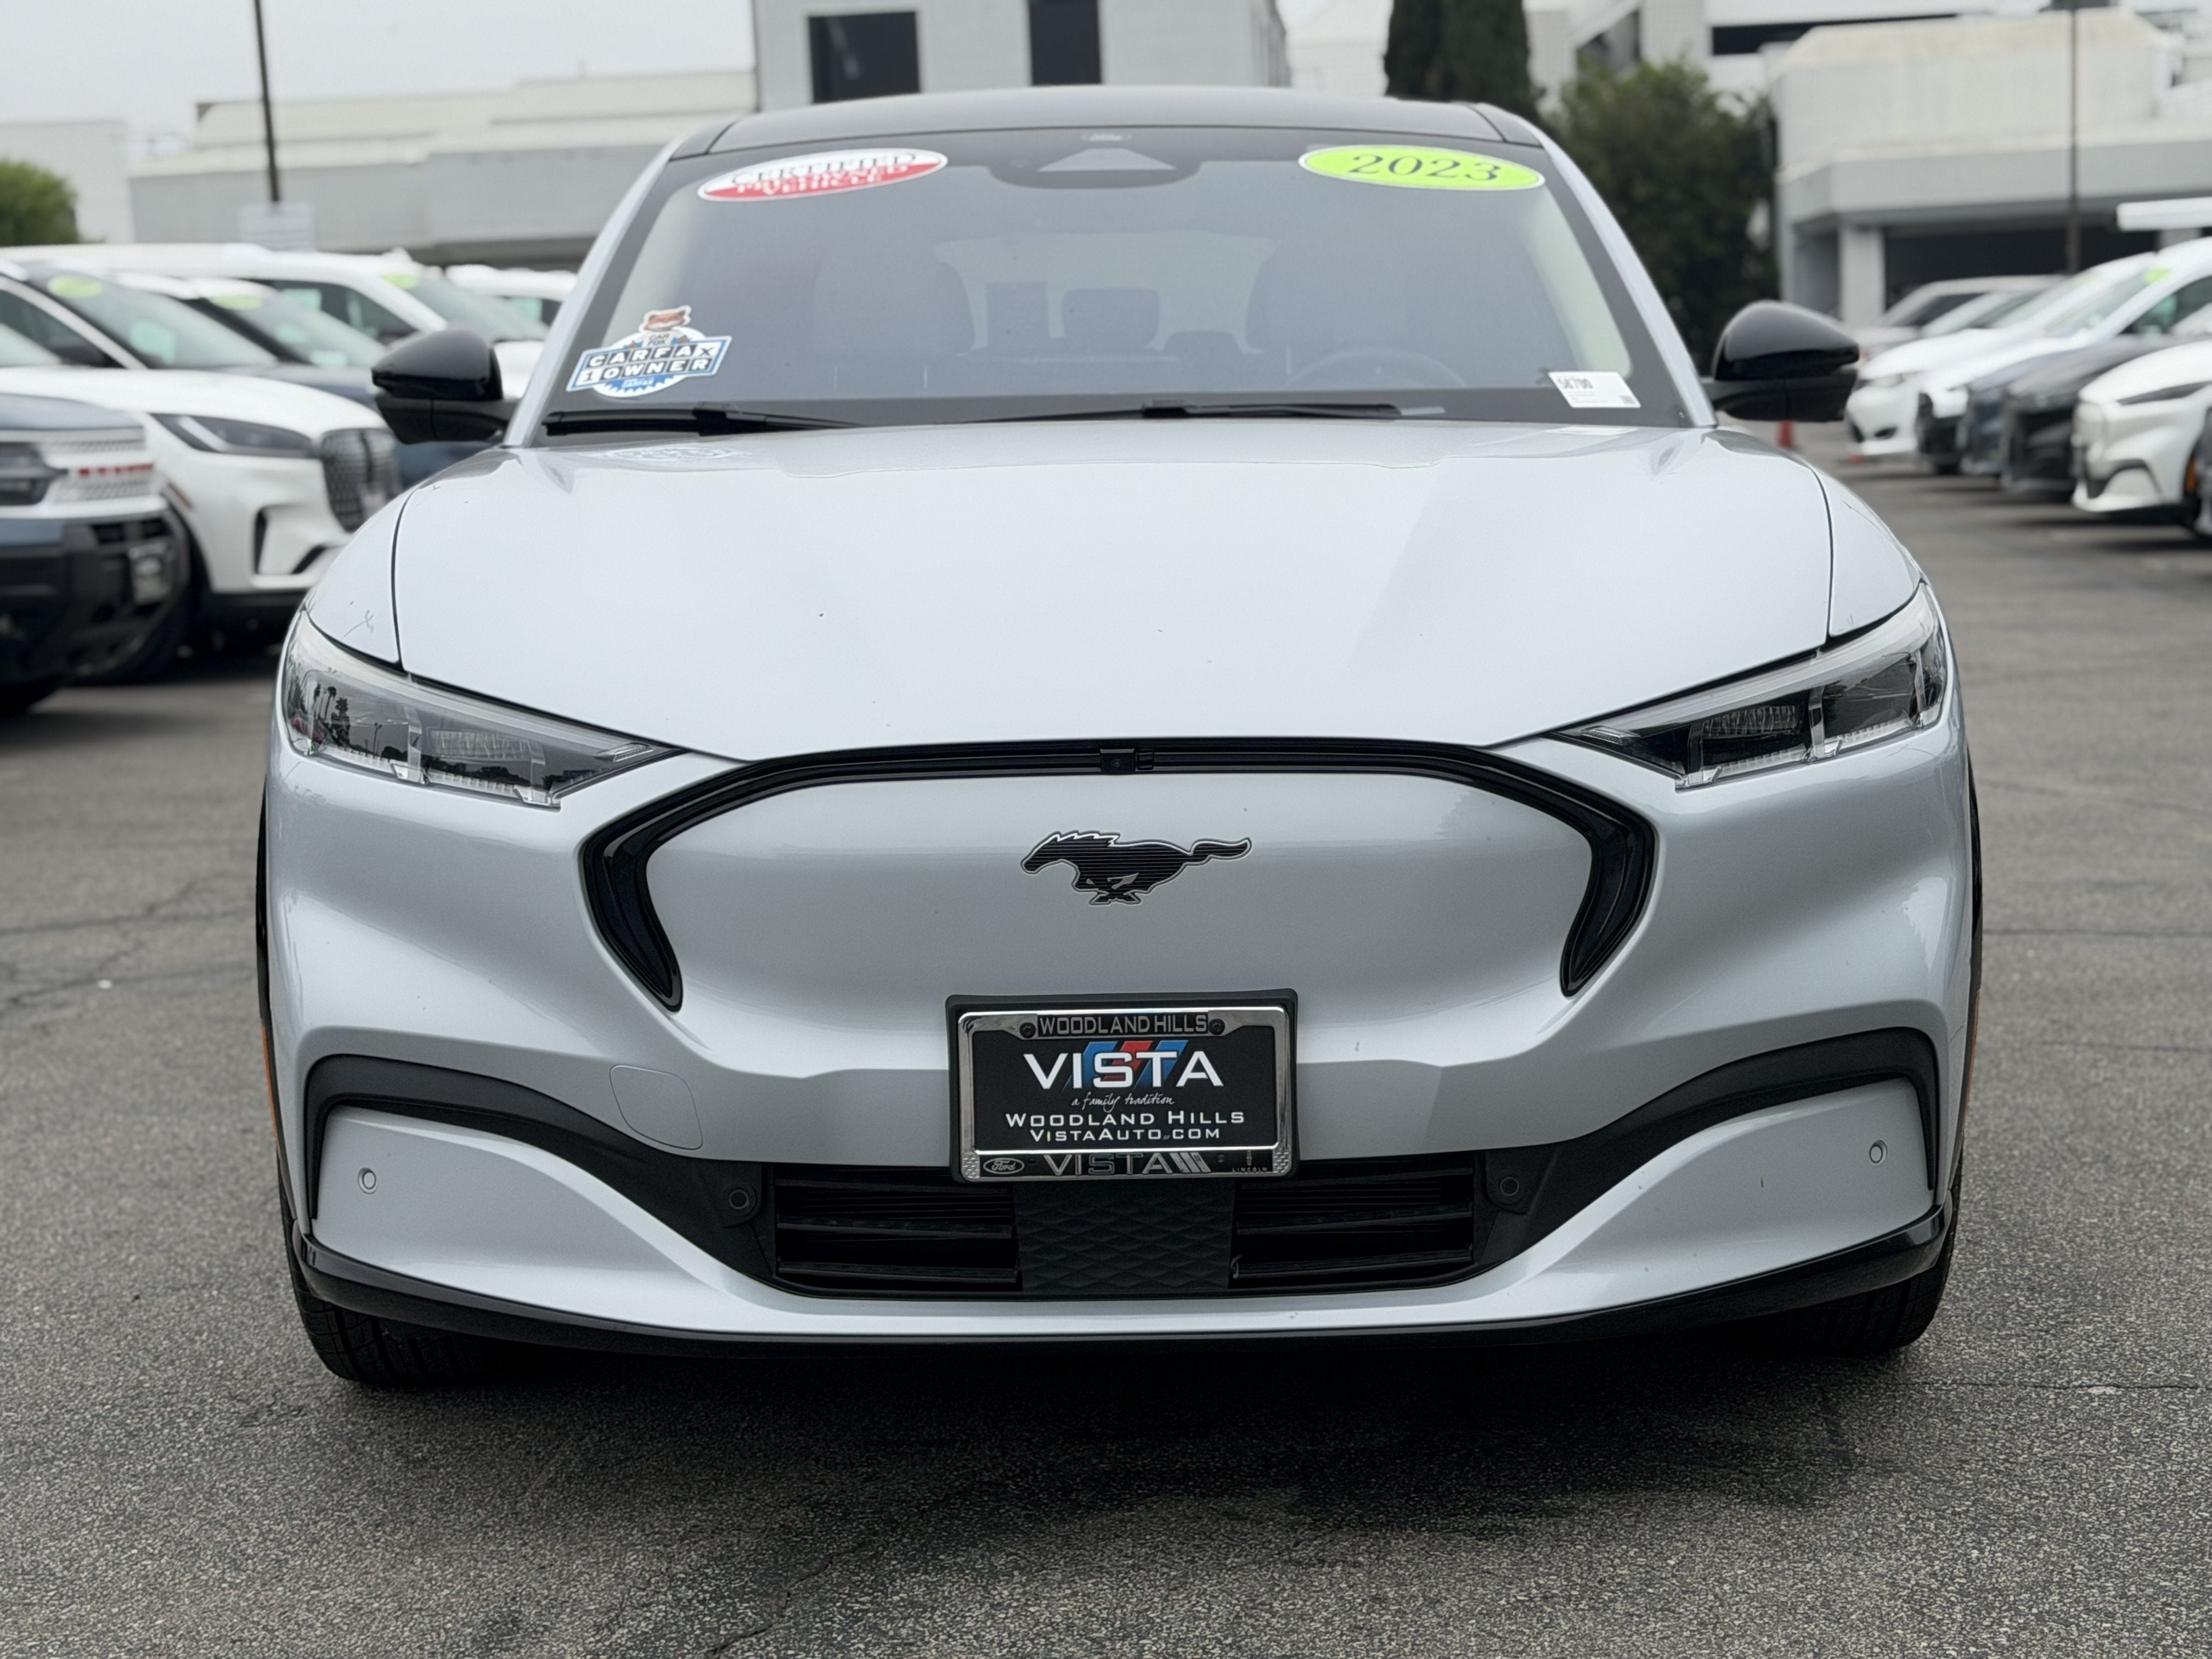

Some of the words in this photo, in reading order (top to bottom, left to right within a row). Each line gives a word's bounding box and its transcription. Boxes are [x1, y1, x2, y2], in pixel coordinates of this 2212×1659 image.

[1347, 154, 1500, 181] 2023
[589, 345, 715, 367] CARFAX
[583, 371, 594, 382] 1
[603, 359, 709, 379] OWNER
[1039, 1015, 1150, 1035] WOODLAND
[1154, 1014, 1207, 1032] HILLS
[1023, 1051, 1224, 1090] VISTA
[1071, 1097, 1080, 1106] a
[1081, 1092, 1120, 1113] family
[1124, 1092, 1175, 1105] tradition
[1005, 1112, 1155, 1127] WOODLAND
[1167, 1110, 1245, 1124] HILLS
[991, 1160, 1017, 1171] Ford
[1043, 1152, 1173, 1176] VISTA
